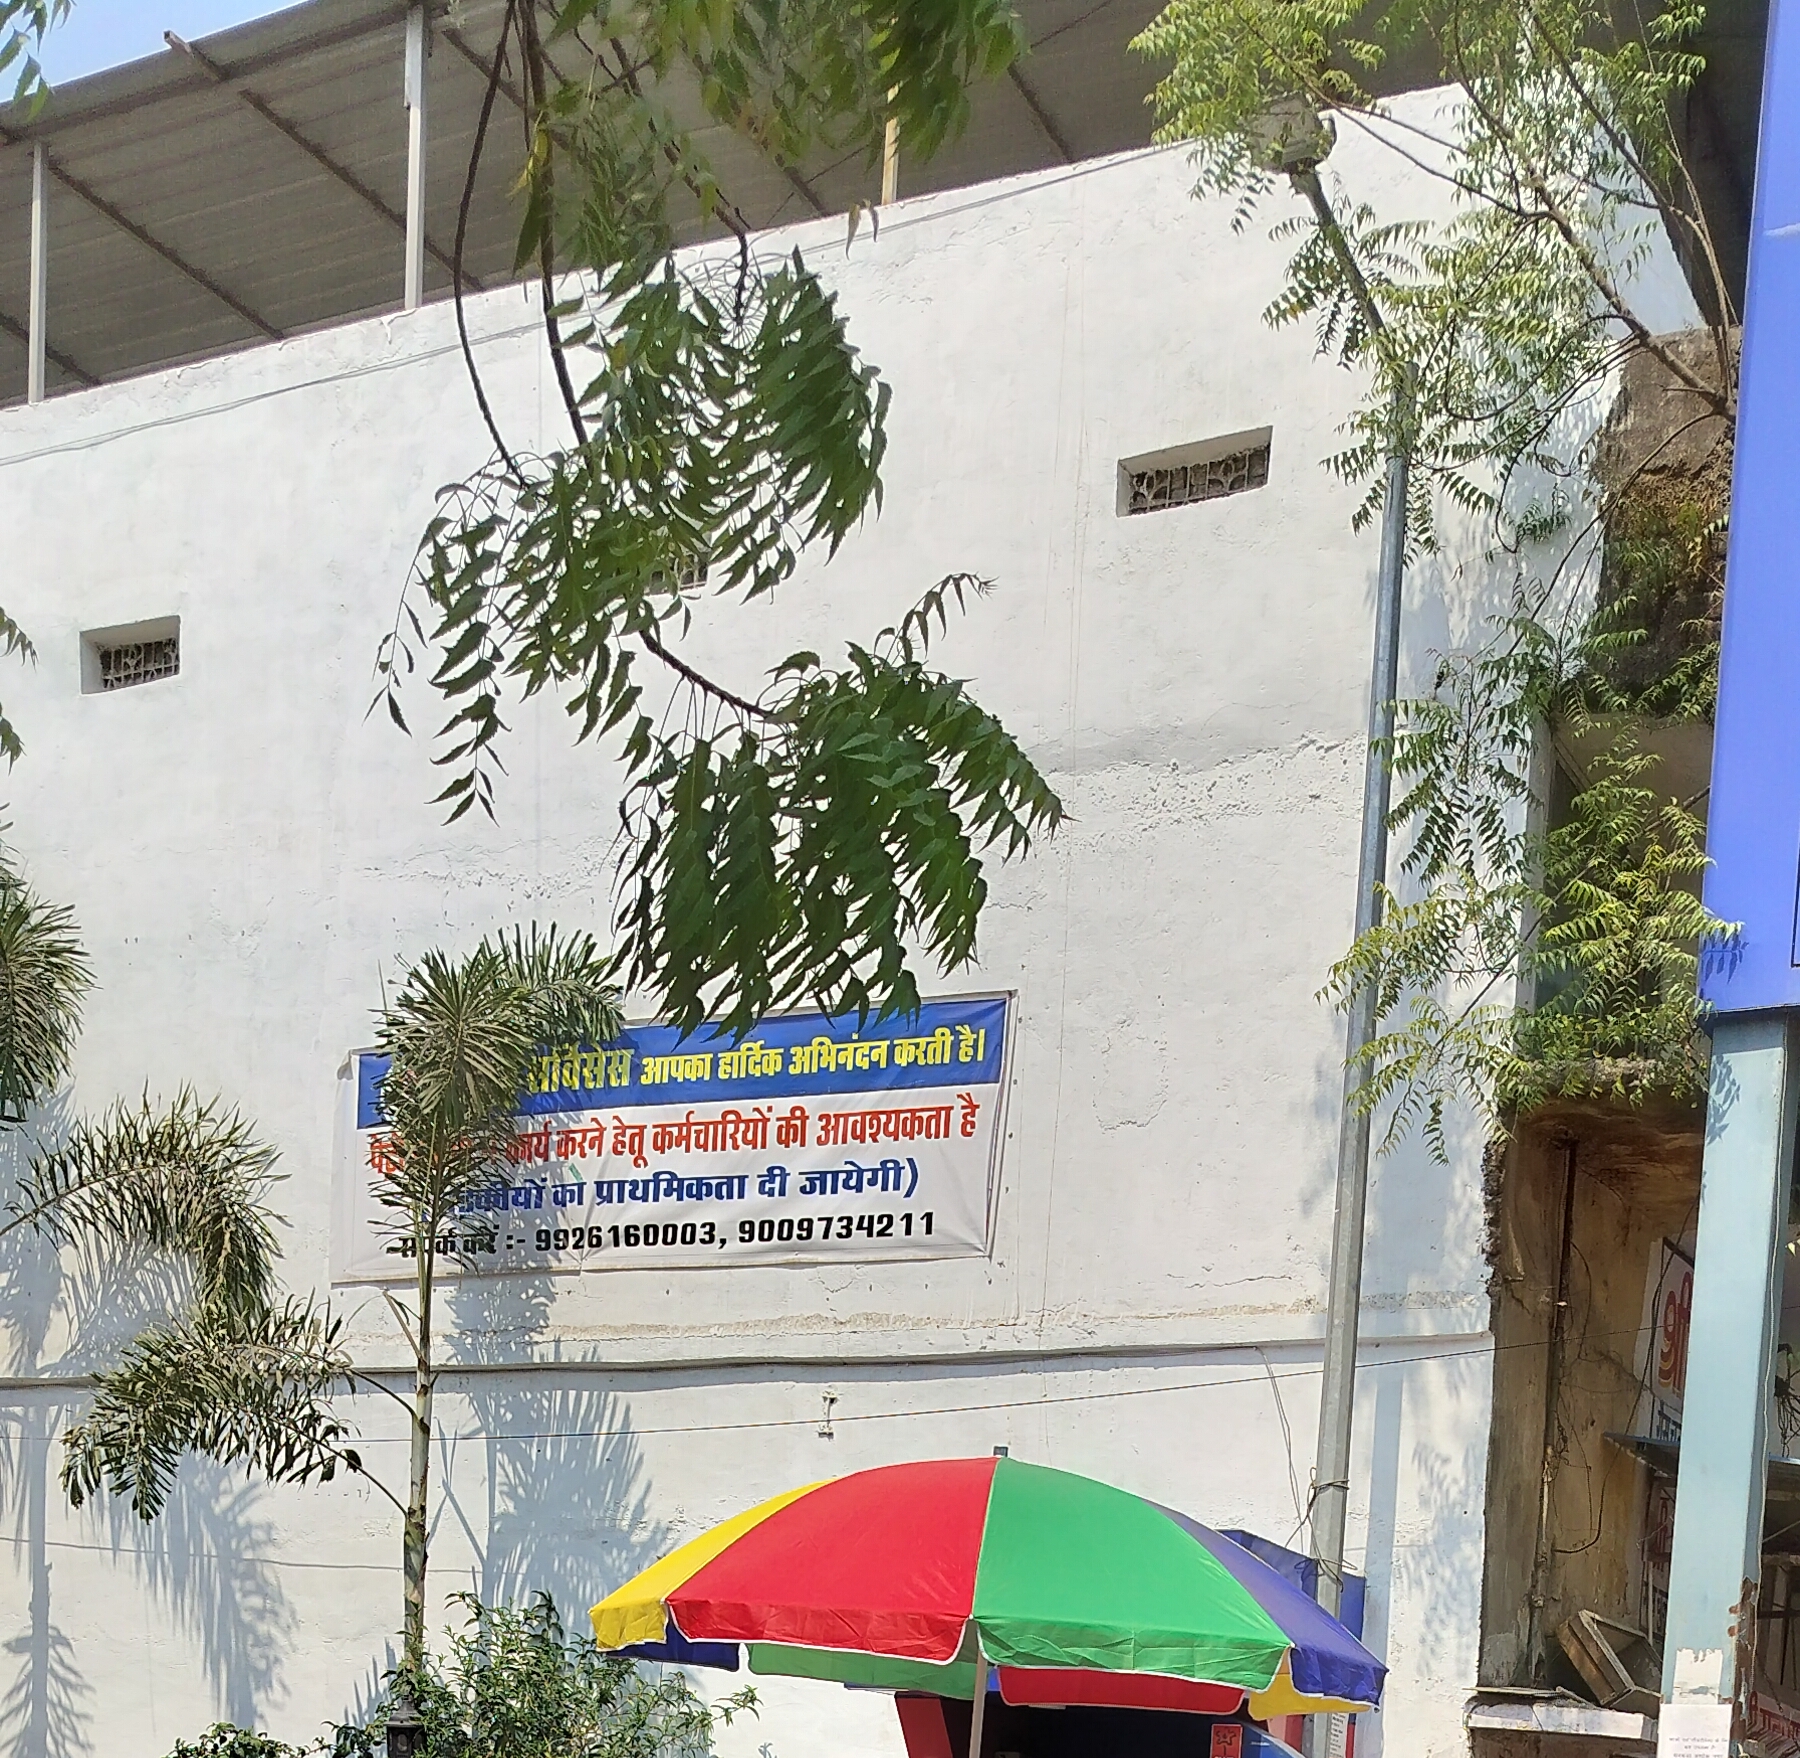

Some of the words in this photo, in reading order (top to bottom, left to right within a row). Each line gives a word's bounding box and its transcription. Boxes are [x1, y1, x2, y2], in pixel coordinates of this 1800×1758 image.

[640, 1051, 712, 1086] आपका
[717, 1040, 783, 1080] हार्दिक
[788, 1033, 888, 1075] अभिनंदन
[893, 1026, 953, 1067] करती
[556, 1117, 606, 1160] करने
[652, 1105, 774, 1155] कर्मचारियों
[776, 1105, 809, 1148] की
[816, 1104, 954, 1146] आवश्यकता
[957, 1092, 981, 1138] है
[551, 1181, 587, 1208] का
[594, 1170, 749, 1207] प्राथमिकता
[756, 1165, 790, 1198] दी
[798, 1157, 919, 1199] जायेगी)
[535, 1222, 728, 1251] 9926160003,
[738, 1211, 935, 1243] 9009734211
